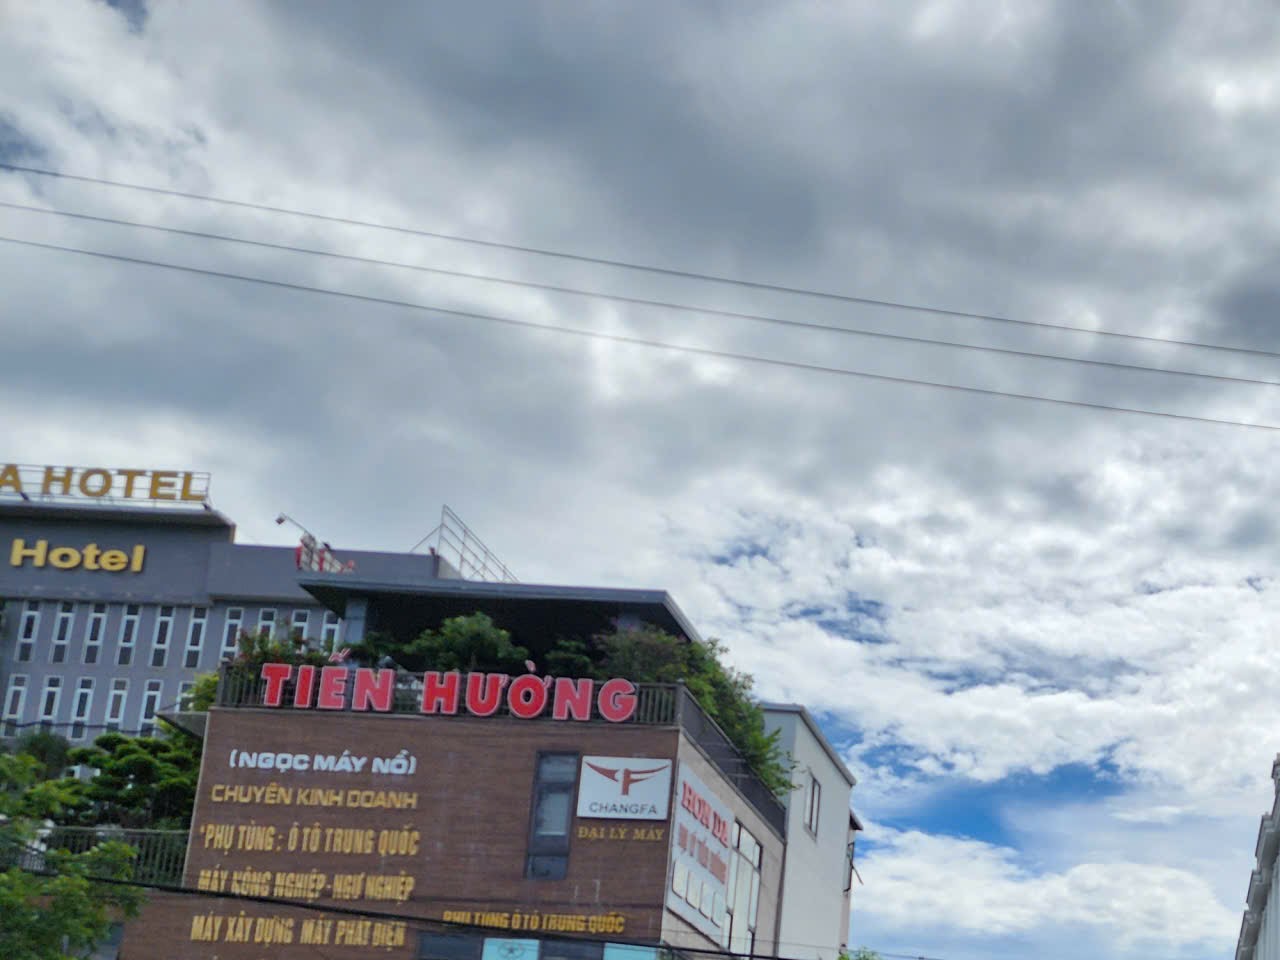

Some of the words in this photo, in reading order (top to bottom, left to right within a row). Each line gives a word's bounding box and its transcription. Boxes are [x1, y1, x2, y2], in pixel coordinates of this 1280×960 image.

[0, 464, 22, 493] A
[41, 465, 207, 501] HOTEL
[9, 538, 146, 573] Hotel
[261, 648, 394, 711] TIẾN
[420, 660, 638, 722] HƯỜNG
[313, 749, 367, 772] MÁY
[211, 782, 293, 805] CHUYÊN
[296, 788, 343, 807] KINH
[346, 789, 419, 809] DOANH
[588, 802, 657, 814] CHANGFA
[288, 821, 300, 851] Ô
[302, 822, 321, 852] TÔ
[325, 827, 375, 854] TRUNG
[378, 823, 421, 856] QUỐC
[190, 911, 222, 940] MÁY
[225, 910, 256, 942] XÂY
[254, 916, 294, 948] DỰNG
[300, 912, 332, 945] MÁY
[542, 913, 586, 933] TRUNG
[588, 911, 625, 934] QUỐC
